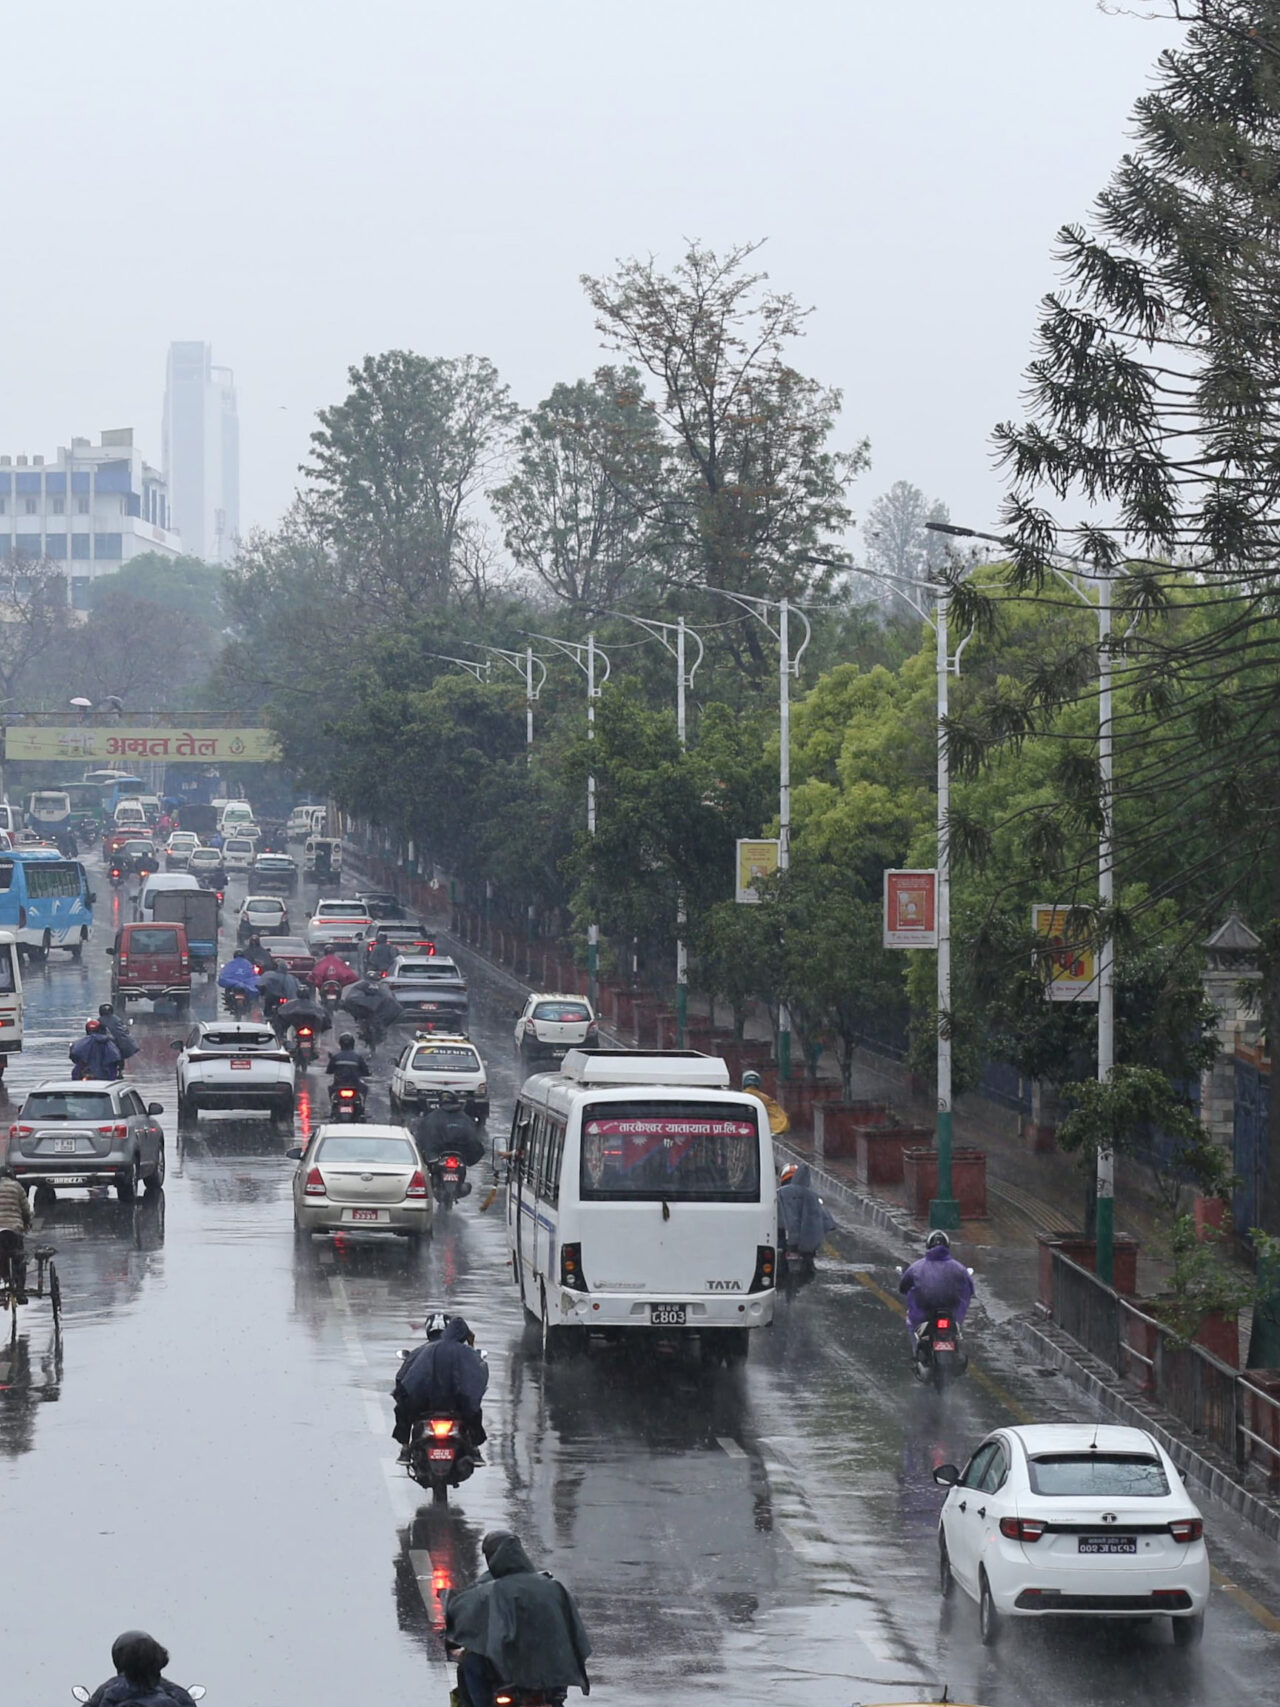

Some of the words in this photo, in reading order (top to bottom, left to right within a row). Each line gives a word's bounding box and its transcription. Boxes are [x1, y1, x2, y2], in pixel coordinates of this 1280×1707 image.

[106, 736, 171, 757] अमृत
[175, 733, 218, 756] तेल
[619, 1121, 662, 1133] तारकेश्वर
[665, 1123, 710, 1133] यातायात
[706, 1280, 741, 1290] TATA
